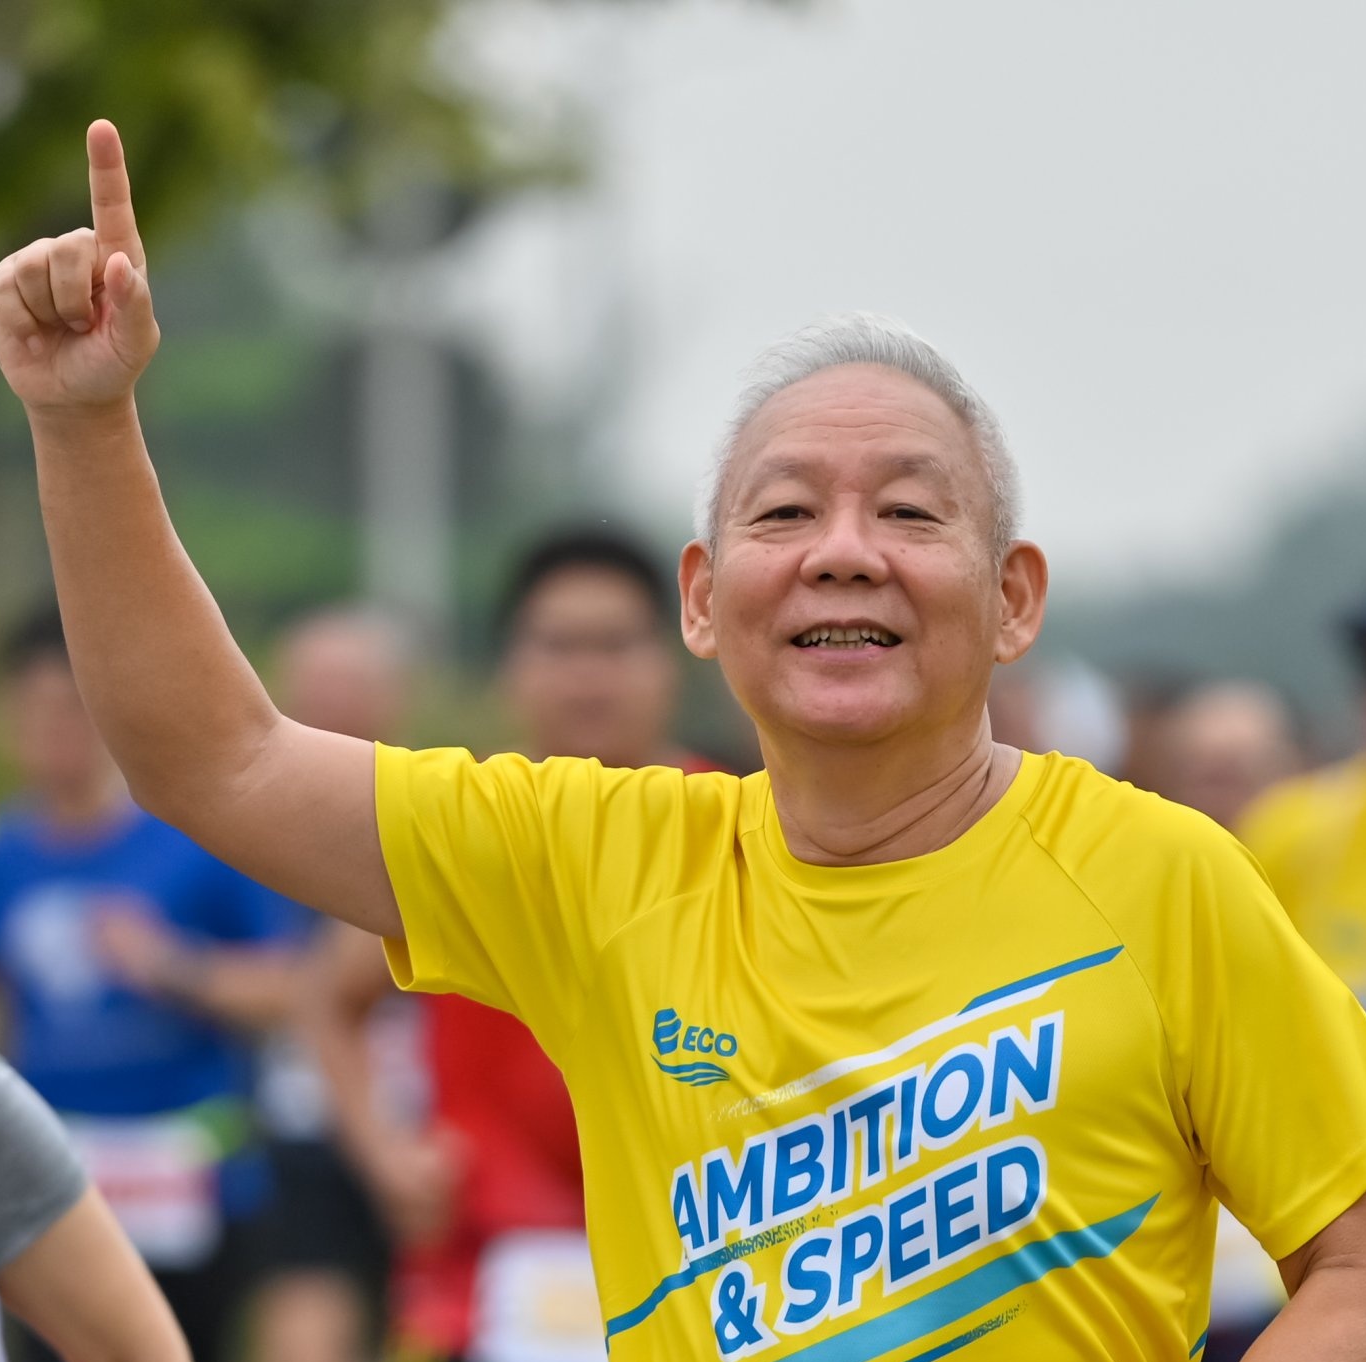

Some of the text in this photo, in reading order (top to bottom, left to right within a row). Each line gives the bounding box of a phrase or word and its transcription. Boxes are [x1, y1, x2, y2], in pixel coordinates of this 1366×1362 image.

[671, 1016, 1061, 1258] AMBITION
[682, 1025, 738, 1058] ECO
[714, 1142, 1043, 1360] & SPEED
